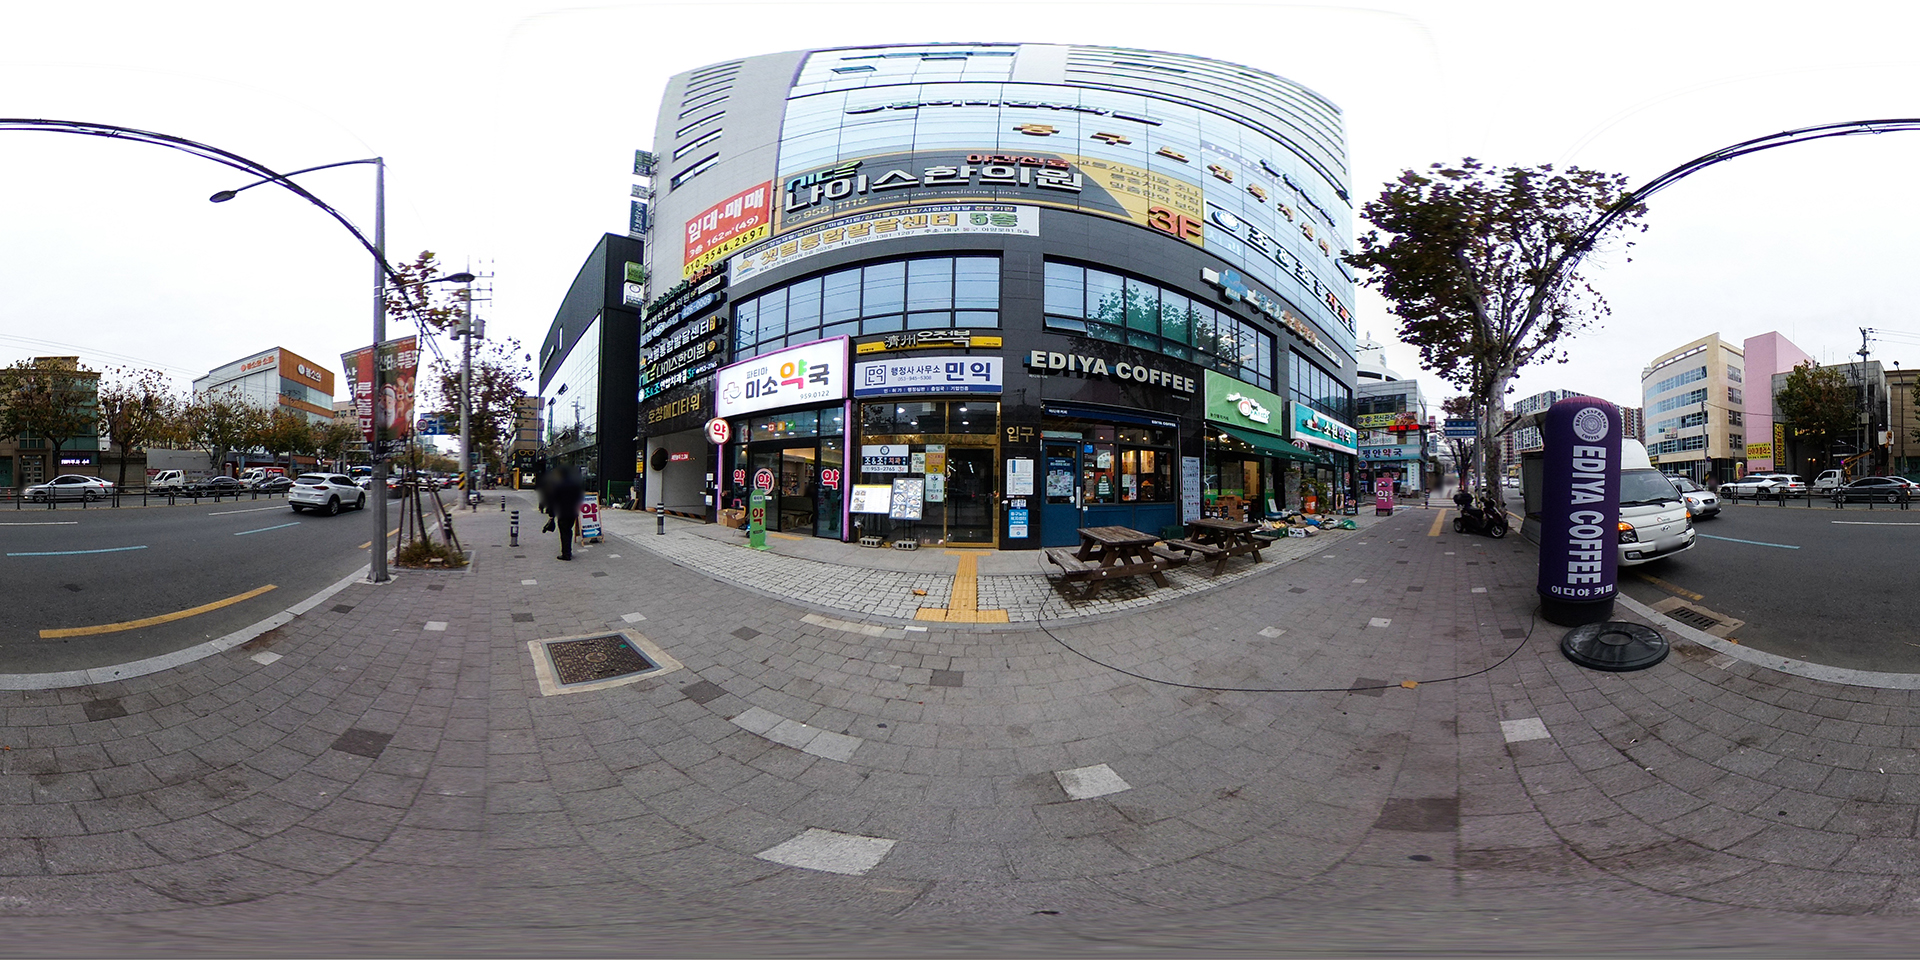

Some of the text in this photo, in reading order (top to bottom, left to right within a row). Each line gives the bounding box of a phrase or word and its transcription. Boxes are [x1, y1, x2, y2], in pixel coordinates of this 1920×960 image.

[786, 164, 1083, 212] 나이스한의원
[803, 196, 868, 219] 958-1115
[1148, 206, 1202, 240] 3F
[760, 212, 1018, 266] 샛별통합발달센터 5층
[684, 226, 764, 275] 010.3544.2697
[656, 341, 706, 379] 나이스한의원
[745, 359, 830, 399] 미소약국
[890, 361, 991, 382] 행정사 사무소 민익
[1030, 350, 1195, 393] EDIYA COFFEE
[713, 422, 727, 440] 약
[1006, 425, 1035, 443] 입구
[733, 469, 746, 487] 약
[758, 473, 771, 490] 약
[821, 468, 840, 490] 약
[581, 503, 598, 522] 약
[752, 507, 765, 526] 약
[1567, 445, 1607, 585] EDIYA COFFEE
[1551, 583, 1613, 597] 이디야 커피
